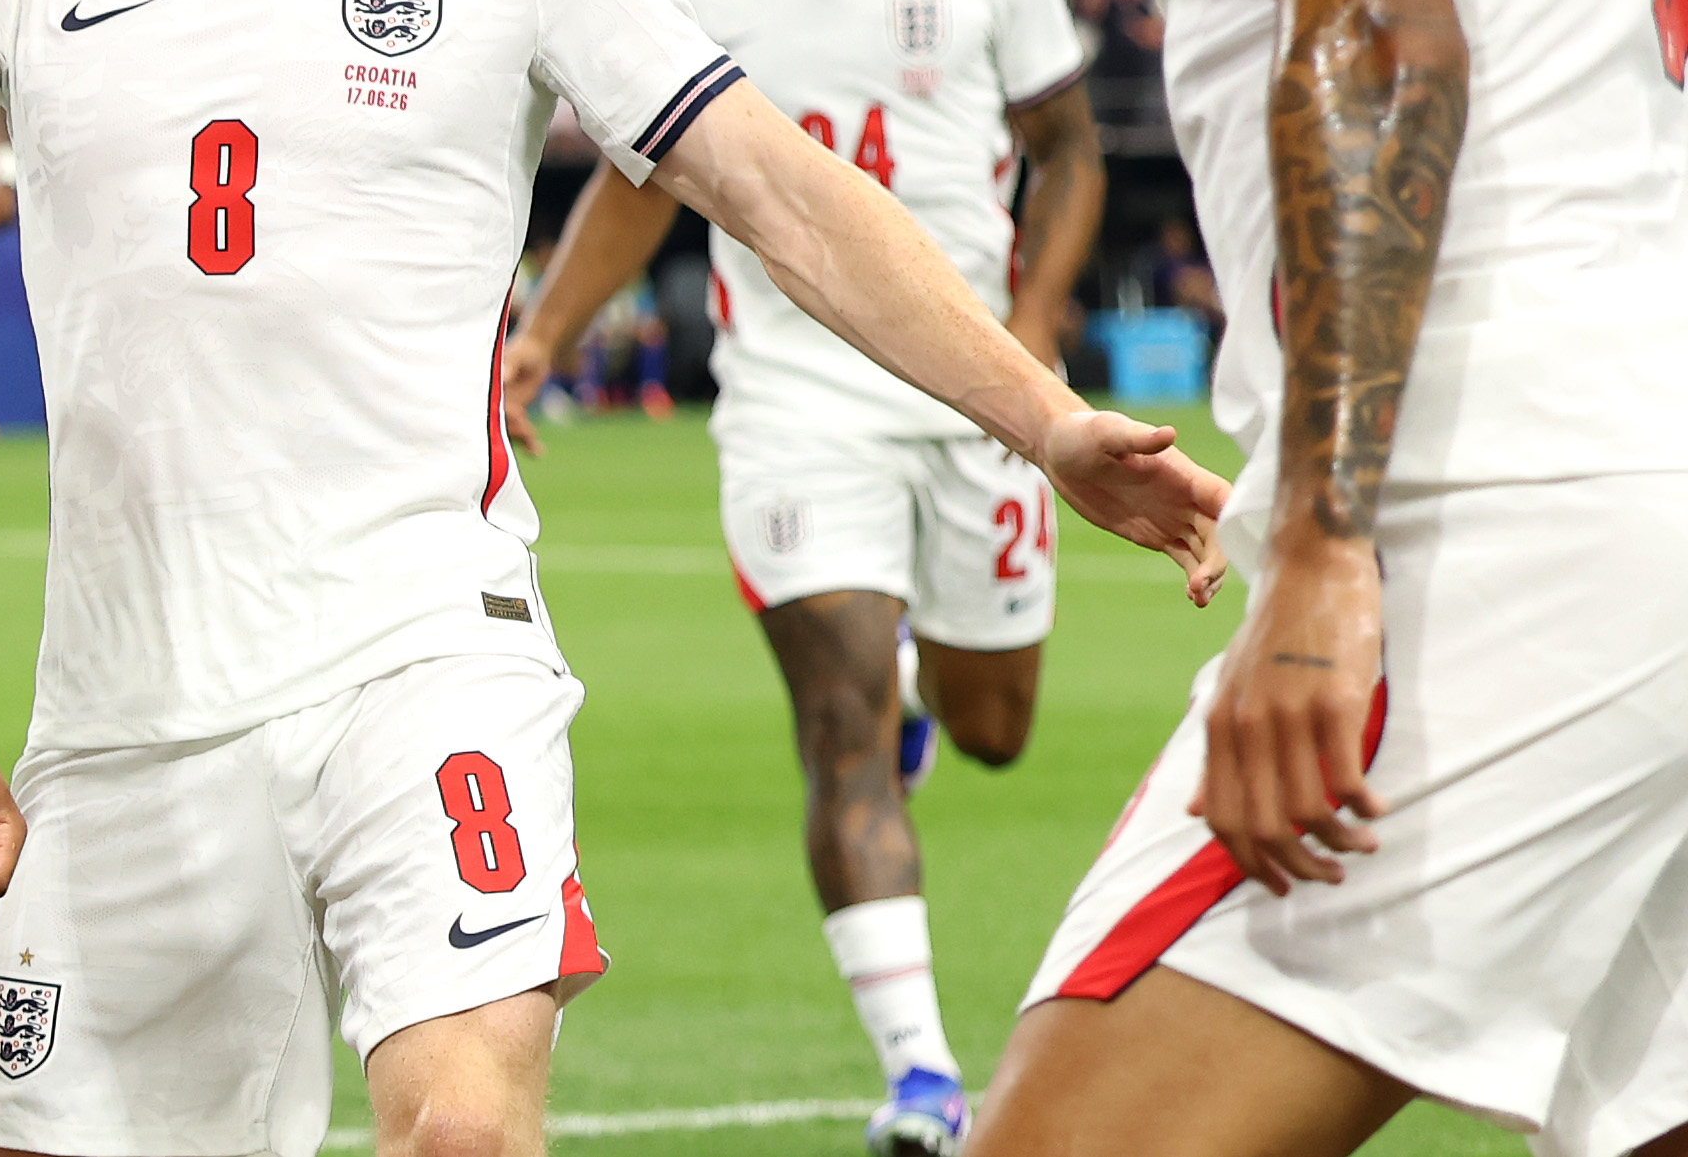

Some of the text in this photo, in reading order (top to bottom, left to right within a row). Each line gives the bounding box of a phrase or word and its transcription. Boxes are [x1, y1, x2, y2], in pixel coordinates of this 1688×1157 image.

[344, 64, 417, 89] CROATIA
[347, 87, 408, 111] 17.06.26
[186, 118, 260, 277] 8
[435, 750, 528, 895] 8
